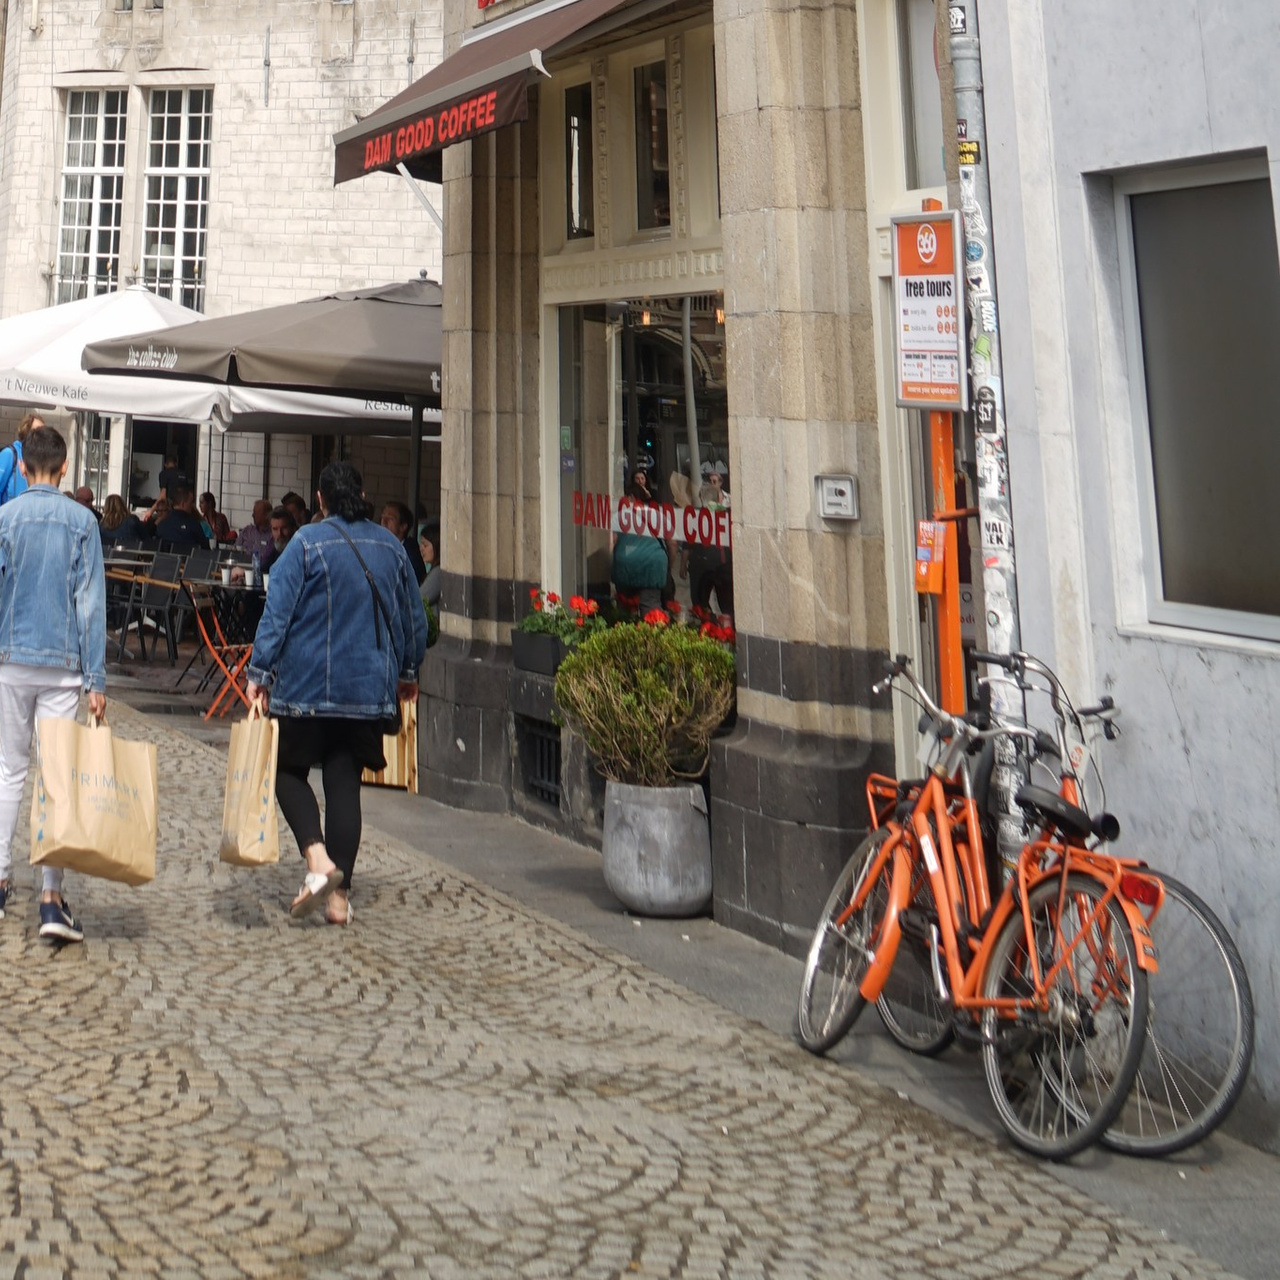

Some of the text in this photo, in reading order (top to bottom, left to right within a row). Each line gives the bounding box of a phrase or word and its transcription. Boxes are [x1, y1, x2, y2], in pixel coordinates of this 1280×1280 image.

[363, 90, 498, 170] DAM GOOD COFFEE
[918, 231, 934, 254] 360
[905, 278, 952, 298] free tours
[138, 343, 162, 368] coffee
[160, 346, 178, 369] club
[4, 378, 11, 390] 't
[14, 378, 59, 397] Nieuwe
[62, 384, 89, 401] Kafé
[572, 490, 733, 550] DAM GOOD COF
